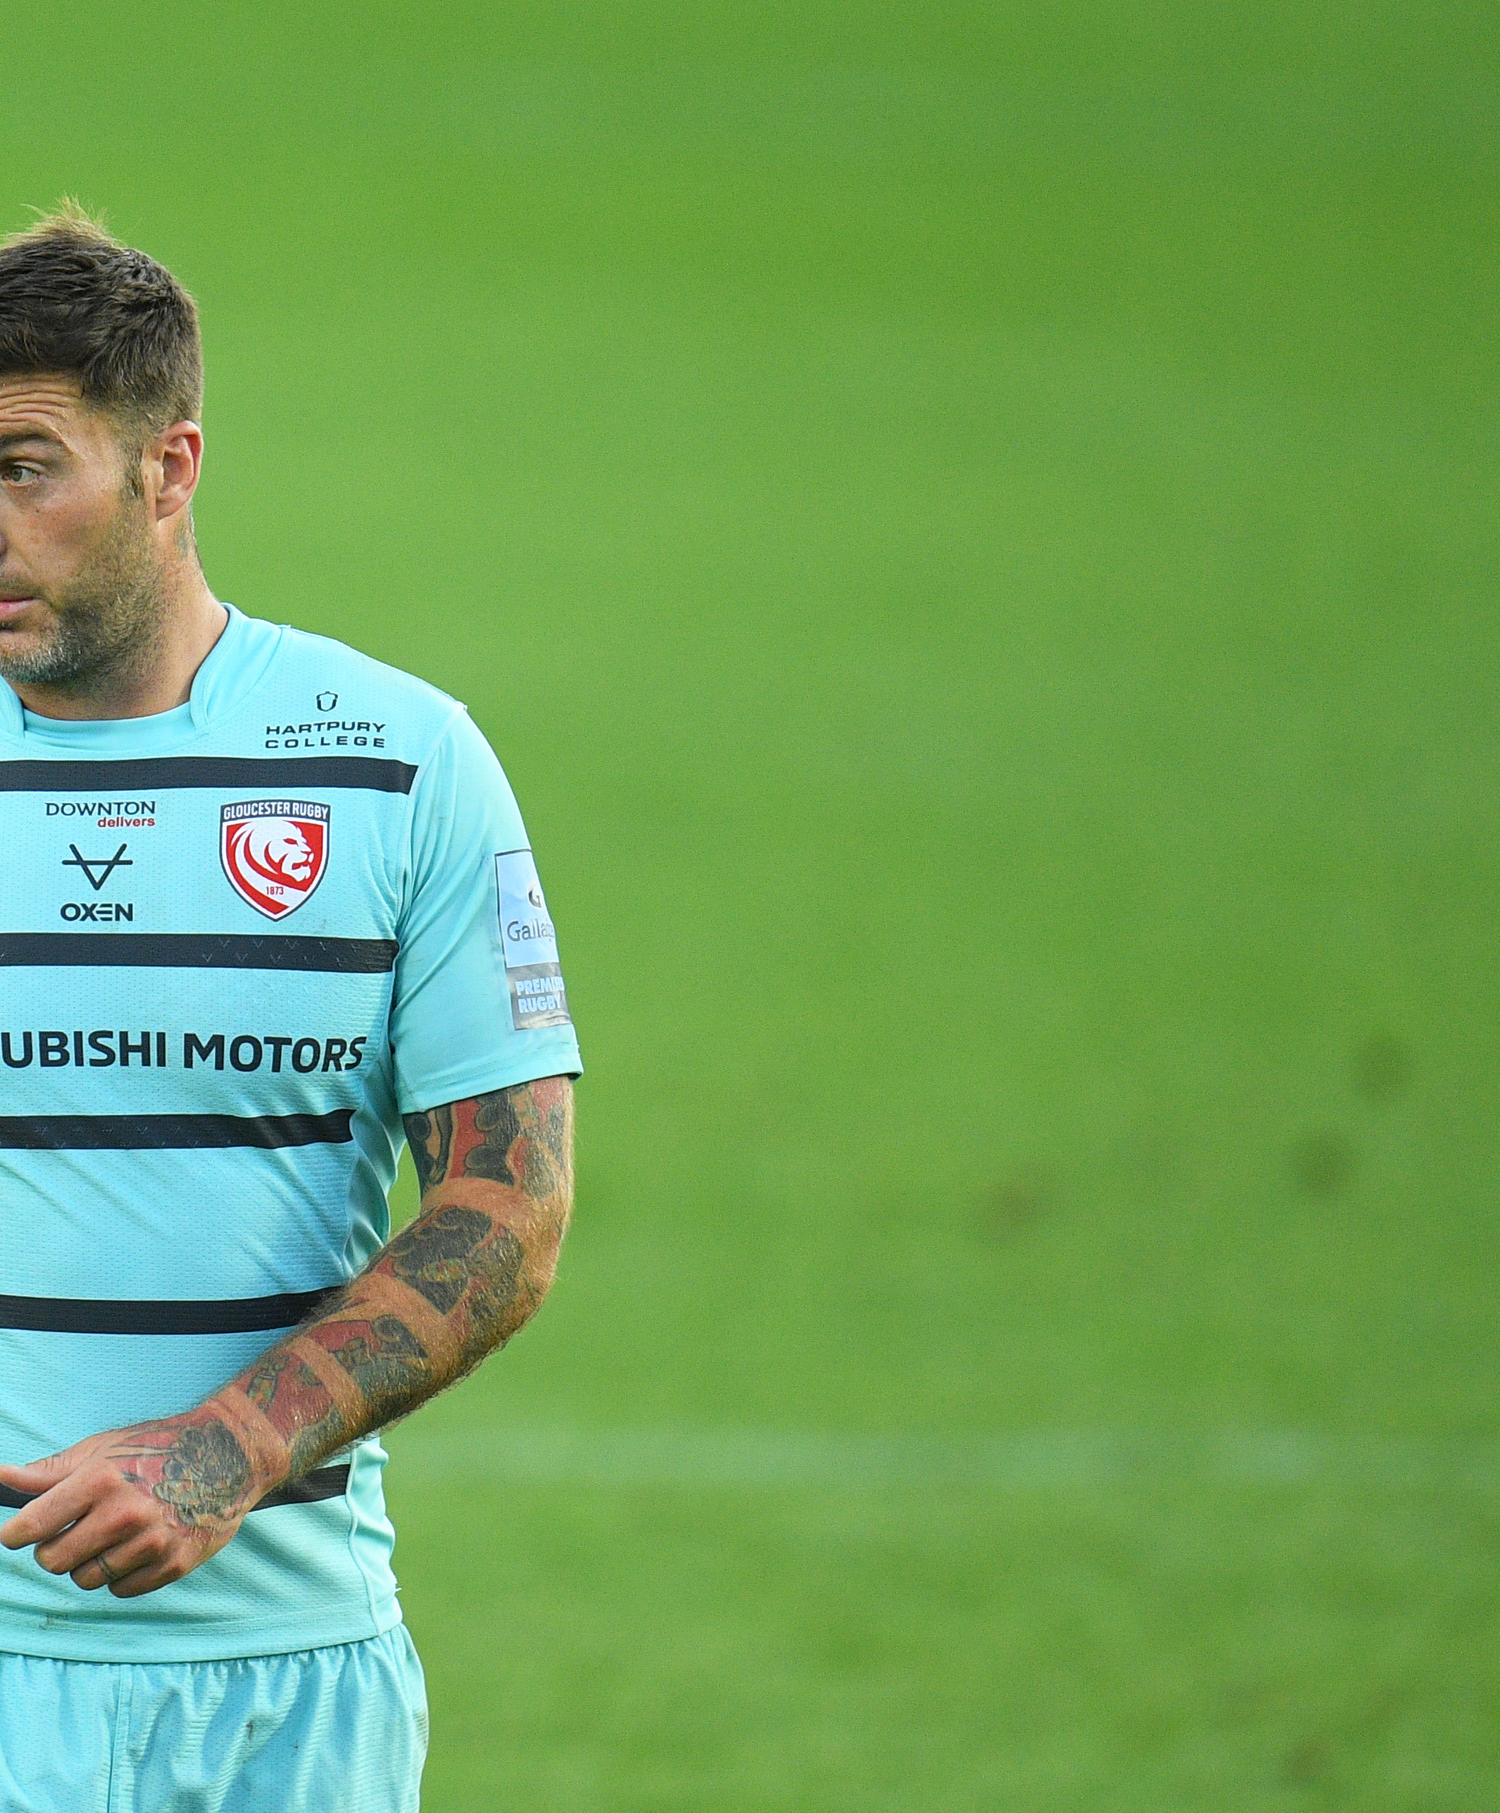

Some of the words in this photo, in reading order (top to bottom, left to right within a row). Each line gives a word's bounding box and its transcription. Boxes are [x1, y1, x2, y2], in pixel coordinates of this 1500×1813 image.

[266, 721, 386, 735] HARTPURY
[265, 736, 385, 748] COLLEGE
[45, 801, 156, 816] DOWNTON
[223, 801, 290, 820] GLOUCESTER
[292, 802, 329, 820] RUGBY
[97, 816, 156, 828] delivers
[266, 886, 284, 895] 1873
[60, 903, 133, 921] OXEN
[518, 996, 562, 1013] RUGBY
[183, 1033, 367, 1073] MOTORS
